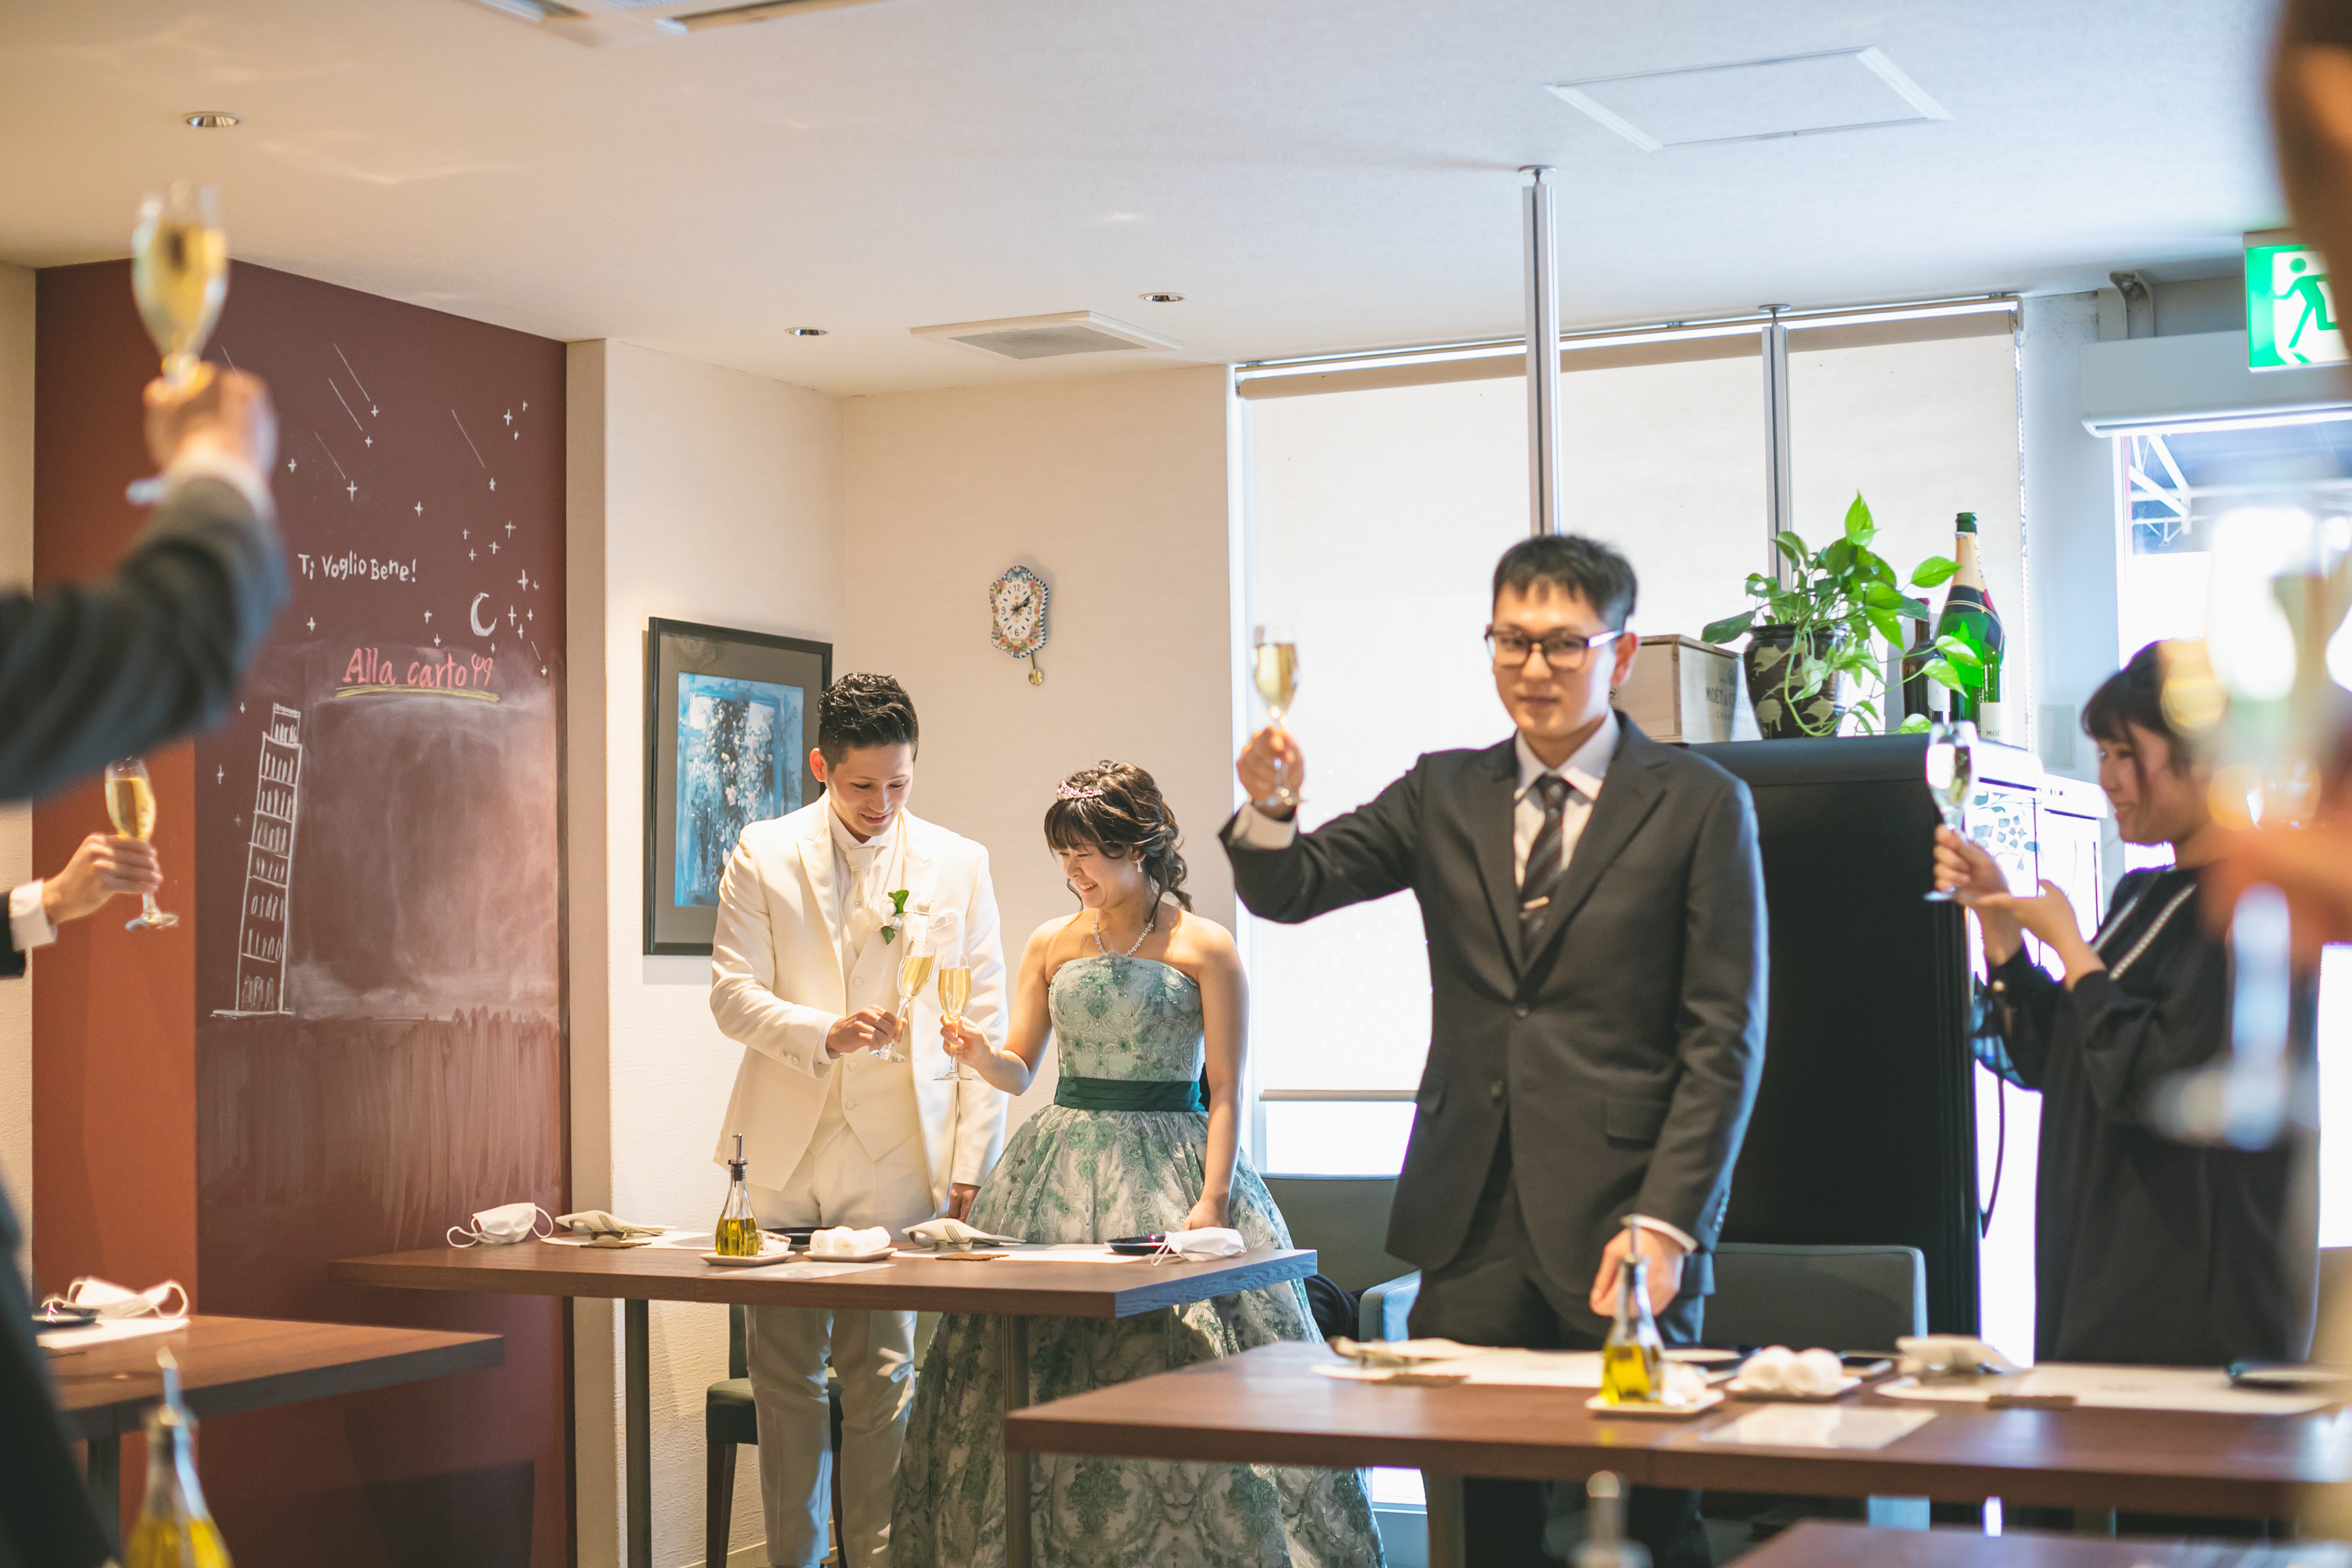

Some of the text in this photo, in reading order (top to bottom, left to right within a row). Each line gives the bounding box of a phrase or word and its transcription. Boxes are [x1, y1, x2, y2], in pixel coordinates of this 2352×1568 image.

[298, 549, 416, 583] Ti Voglio Bene!
[1013, 583, 1021, 592] 12
[1001, 606, 1006, 615] 9
[1028, 606, 1032, 615] 3
[1015, 629, 1019, 637] 6
[342, 647, 397, 685] Alla
